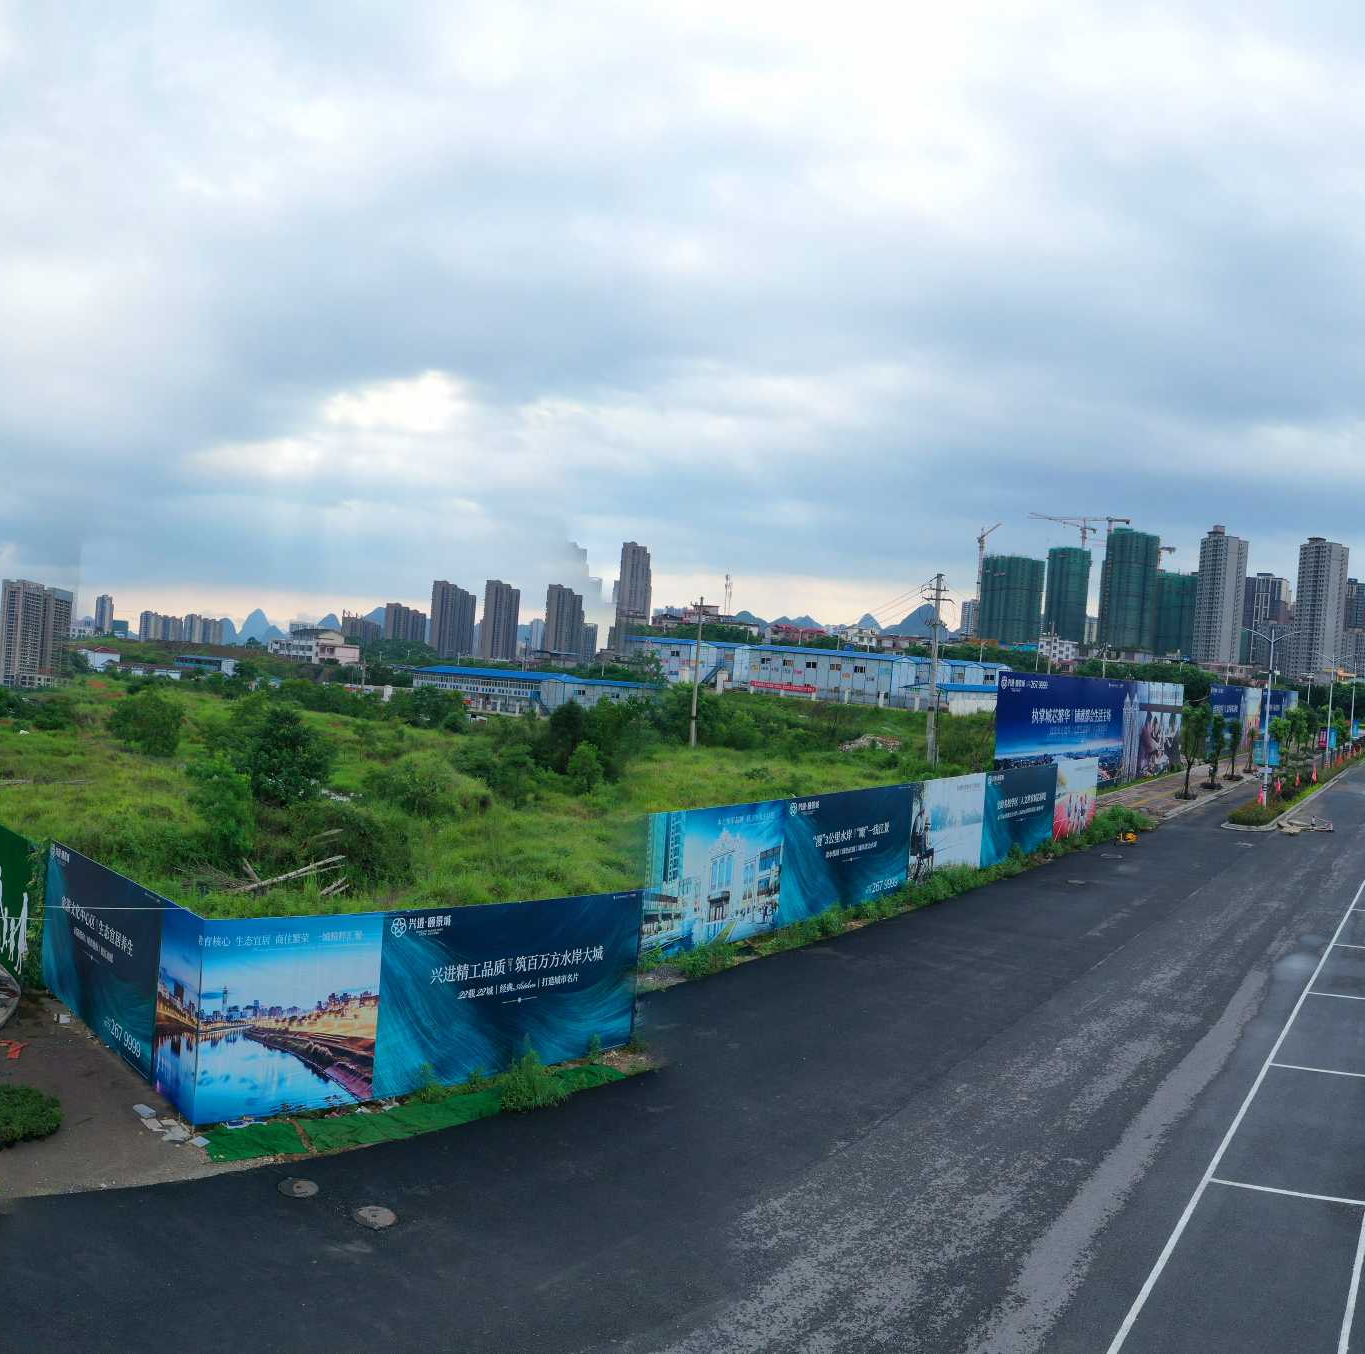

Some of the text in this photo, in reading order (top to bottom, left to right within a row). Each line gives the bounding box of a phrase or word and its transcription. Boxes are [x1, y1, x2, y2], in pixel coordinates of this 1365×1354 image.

[408, 914, 452, 930] 兴进·颐景城
[236, 935, 270, 947] 生态宜居
[430, 960, 507, 986] 兴进精工品质
[514, 944, 605, 974] 筑百万方水岸大城
[541, 972, 580, 987] 打造城市名片
[110, 1018, 123, 1042] 267
[123, 1032, 142, 1059] 9999
